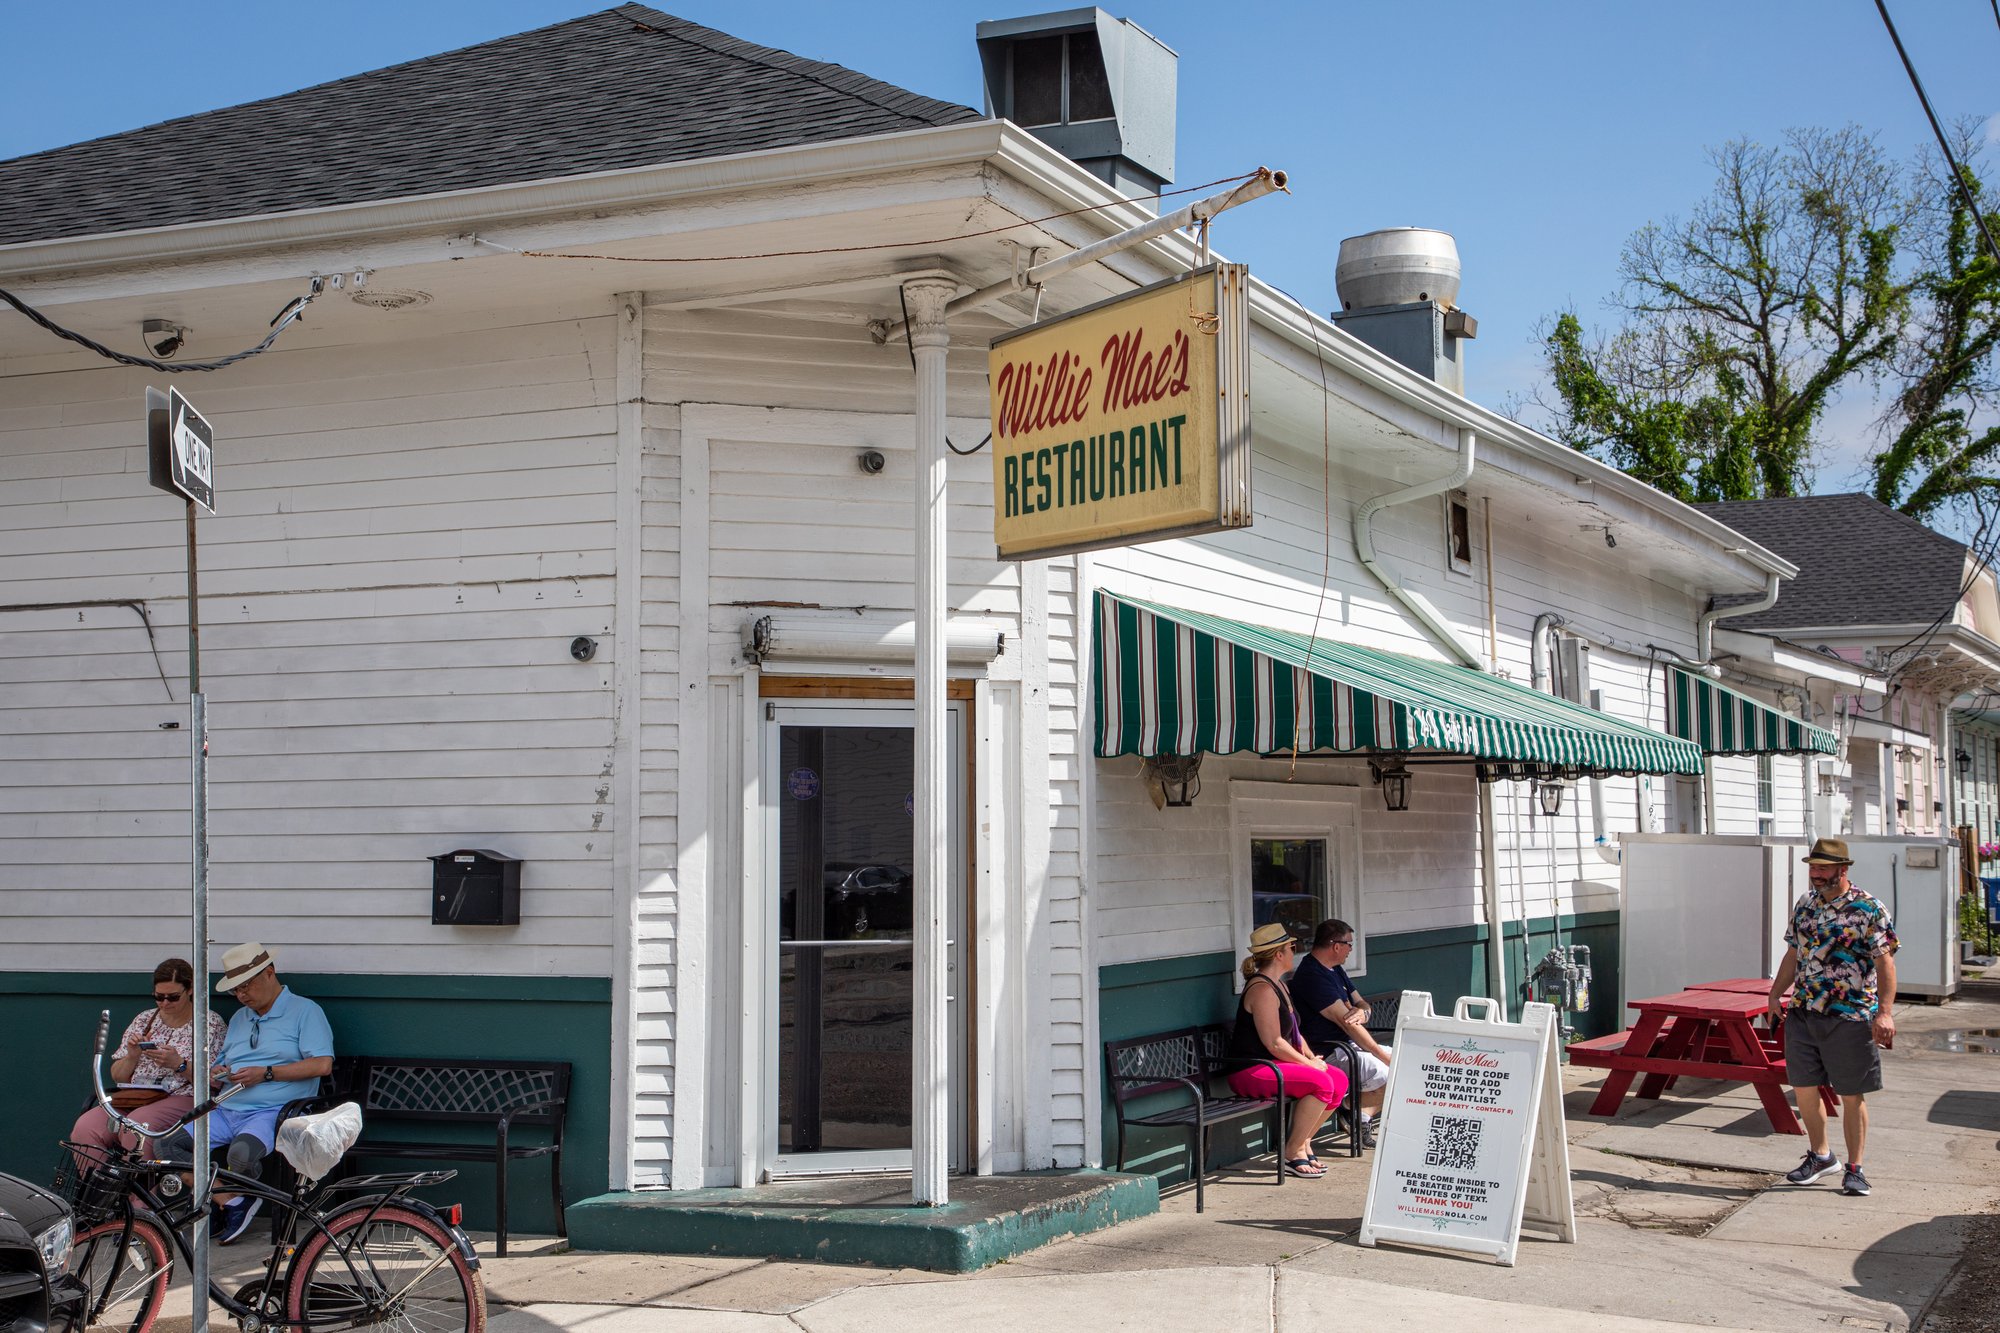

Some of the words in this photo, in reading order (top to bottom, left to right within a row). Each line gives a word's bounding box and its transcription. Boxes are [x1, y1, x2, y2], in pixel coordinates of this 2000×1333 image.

[997, 349, 1092, 439] Willie
[1101, 327, 1190, 415] Mae's
[185, 431, 197, 471] ONE
[198, 441, 210, 483] WAY
[1004, 414, 1186, 518] RESTAURANT
[1436, 1049, 1464, 1065] Willie
[1465, 1053, 1499, 1068] Mae's
[1422, 1064, 1441, 1072] USE
[1444, 1067, 1463, 1075] THE
[1466, 1068, 1480, 1077] QR
[1483, 1071, 1510, 1079] CODE
[1428, 1074, 1462, 1084] BELOW
[1480, 1079, 1500, 1087] ADD
[1424, 1082, 1450, 1091] YOUR
[1454, 1085, 1485, 1094] PARTY
[1489, 1088, 1502, 1096] TO
[1425, 1090, 1446, 1099] OUR
[1449, 1093, 1497, 1104] WAITLIST.
[1476, 1106, 1506, 1114] CONTACT
[1396, 1170, 1428, 1180] PLEASE
[1430, 1175, 1454, 1183] COME
[1457, 1178, 1486, 1187] INSIDE
[1410, 1188, 1448, 1198] MINUTES
[1465, 1195, 1488, 1203] TEXT.
[1420, 1181, 1452, 1190] SEATED
[1455, 1186, 1486, 1195] WITHIN
[1415, 1196, 1447, 1206] THANK
[1450, 1201, 1473, 1209] YOU!
[1397, 1205, 1488, 1221] WILLIEMAESNOLA.COM
